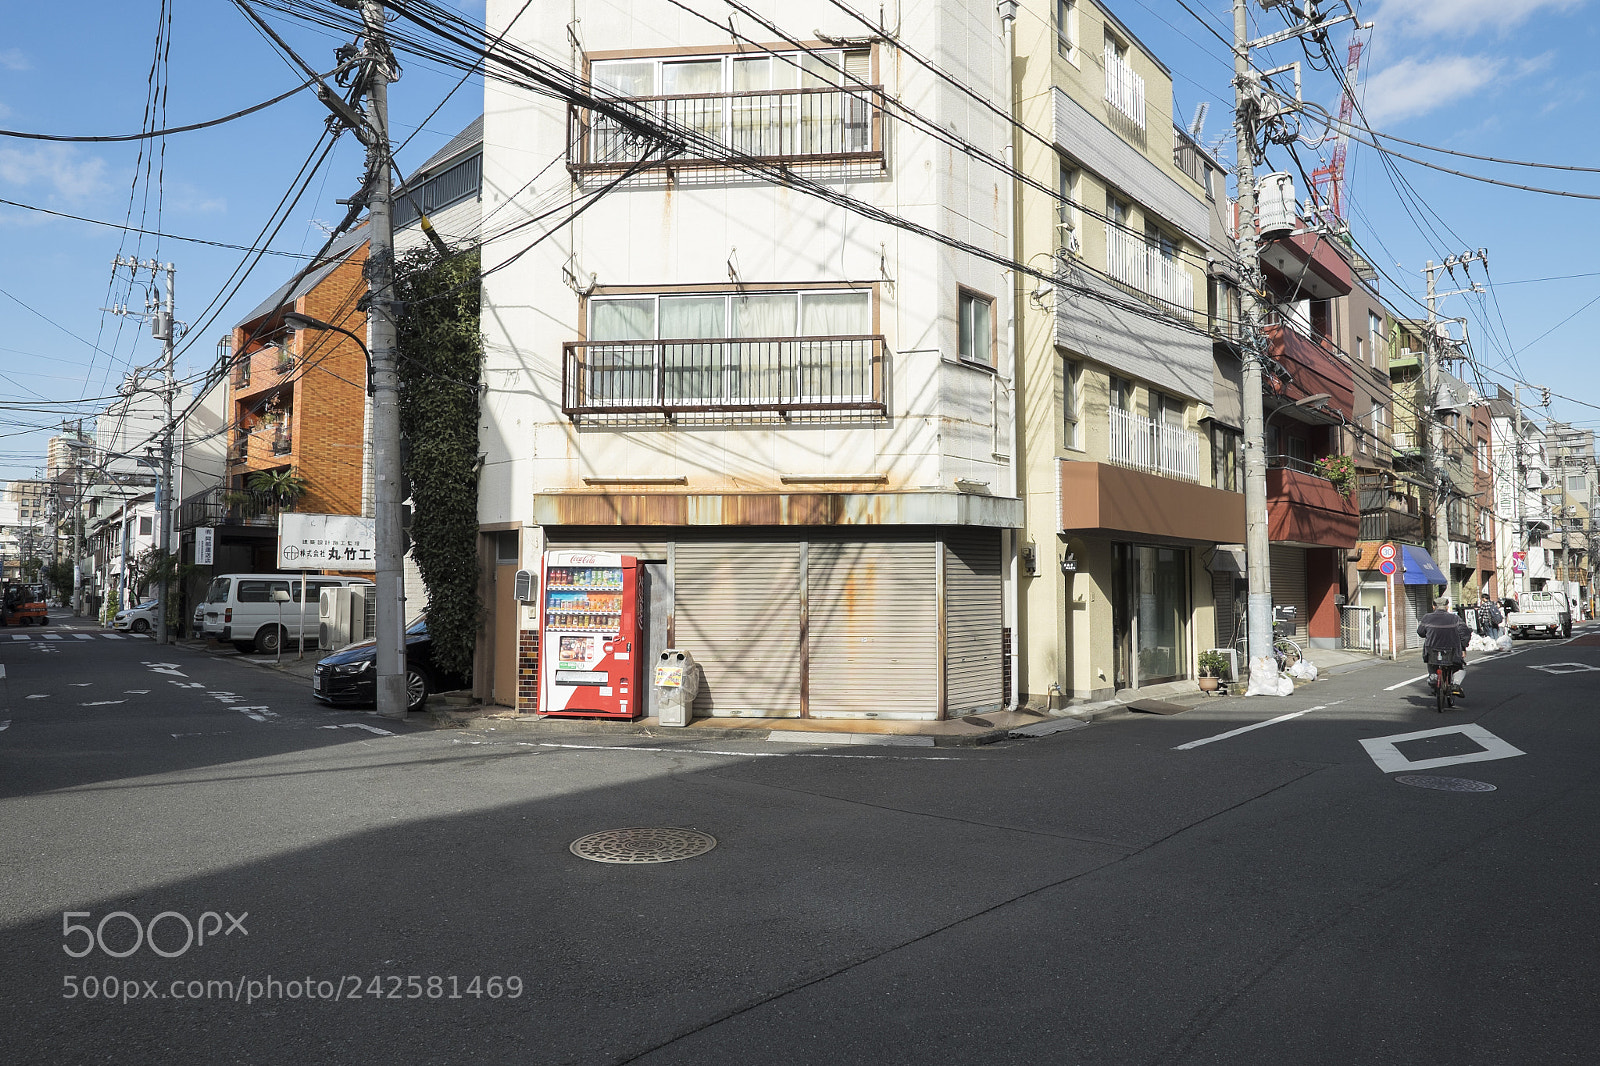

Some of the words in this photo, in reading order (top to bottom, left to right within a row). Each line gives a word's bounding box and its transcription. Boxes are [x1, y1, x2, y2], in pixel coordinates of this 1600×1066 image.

[299, 547, 376, 560] 株式会社丸竹工
[1383, 548, 1392, 556] 30
